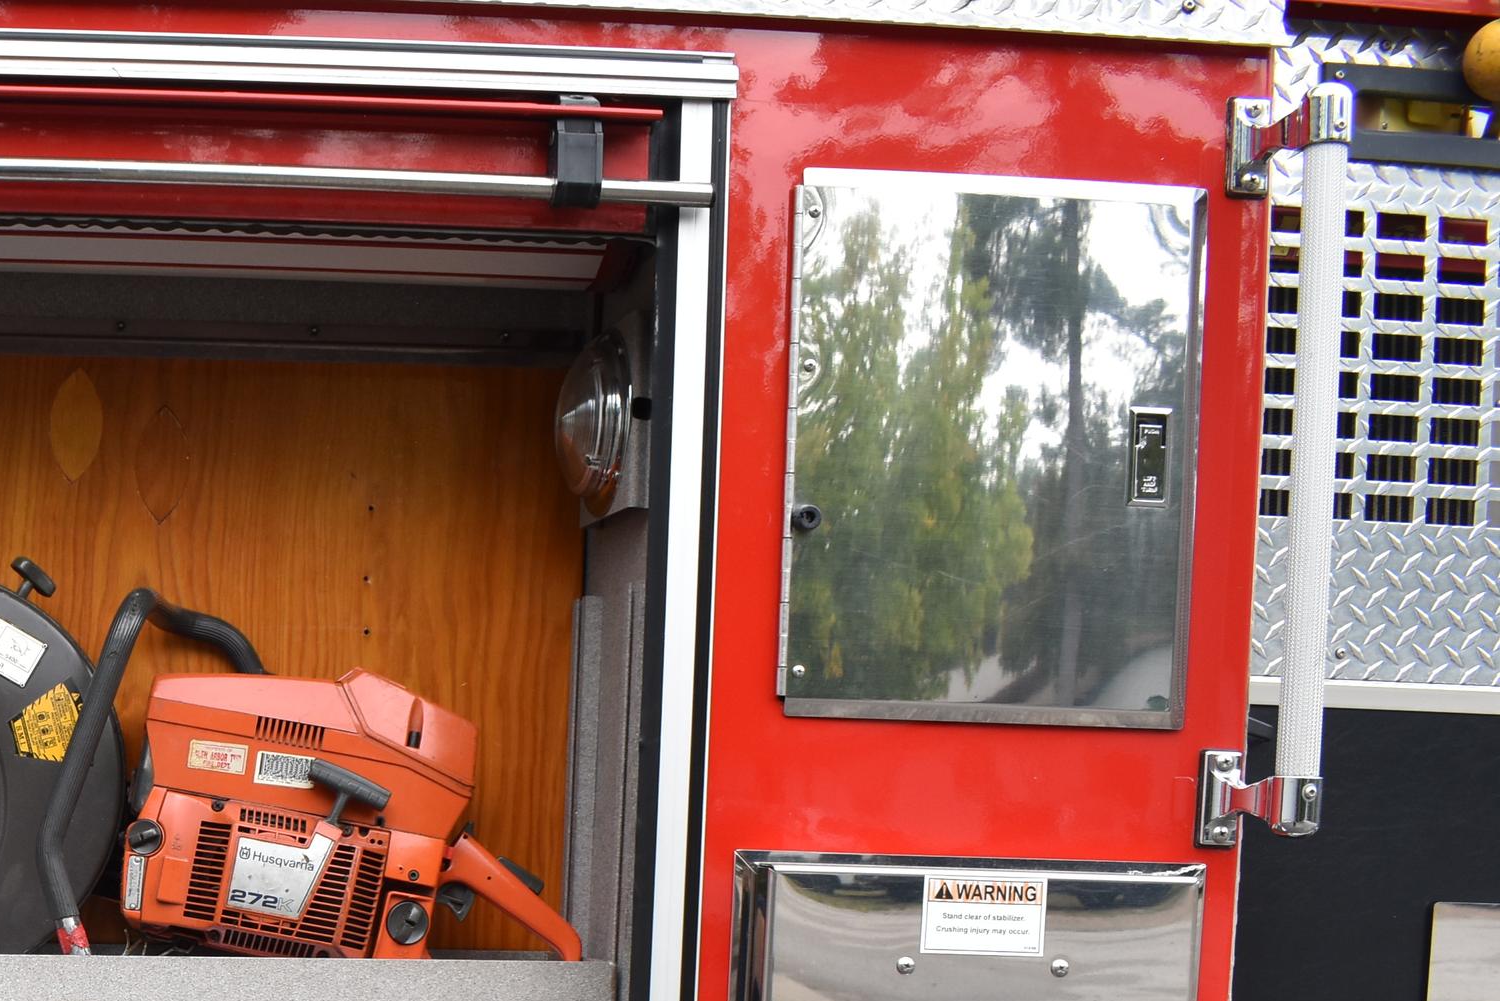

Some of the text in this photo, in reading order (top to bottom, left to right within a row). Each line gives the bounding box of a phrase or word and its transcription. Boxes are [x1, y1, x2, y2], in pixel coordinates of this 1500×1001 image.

[252, 851, 315, 872] Husqvarna
[229, 888, 294, 913] 272K
[956, 884, 1037, 902] WARNING
[942, 912, 963, 920] Stand
[936, 925, 969, 934] Crushing
[970, 927, 990, 935] injury
